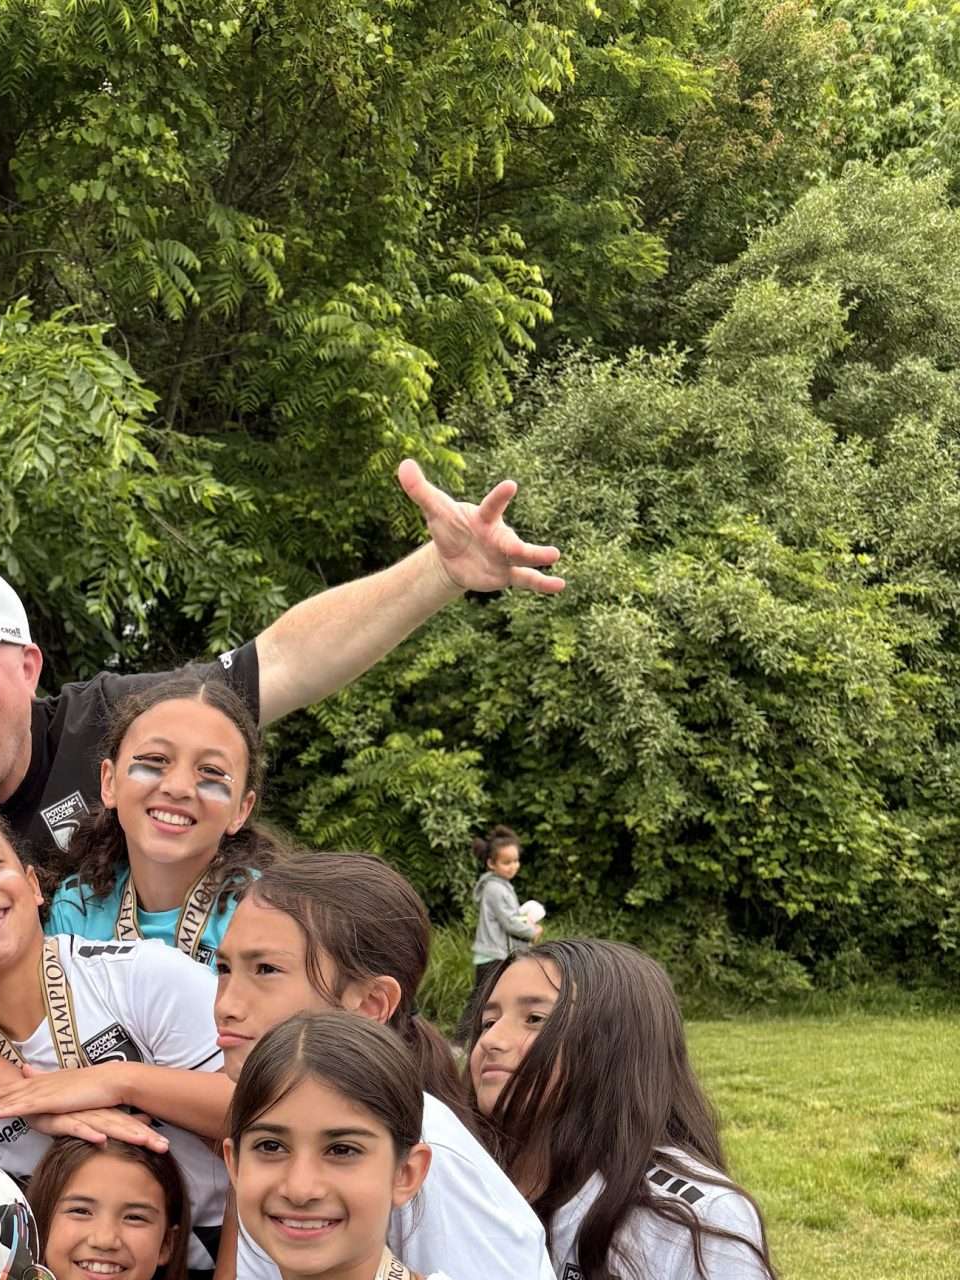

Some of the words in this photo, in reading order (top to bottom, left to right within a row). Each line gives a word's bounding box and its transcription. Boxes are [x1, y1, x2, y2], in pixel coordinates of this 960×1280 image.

[45, 797, 77, 819] POTOMAC
[48, 807, 74, 825] SOCCER
[119, 891, 133, 937] CHA
[86, 1028, 120, 1053] POTOMAC
[90, 1038, 118, 1060] SOCCER
